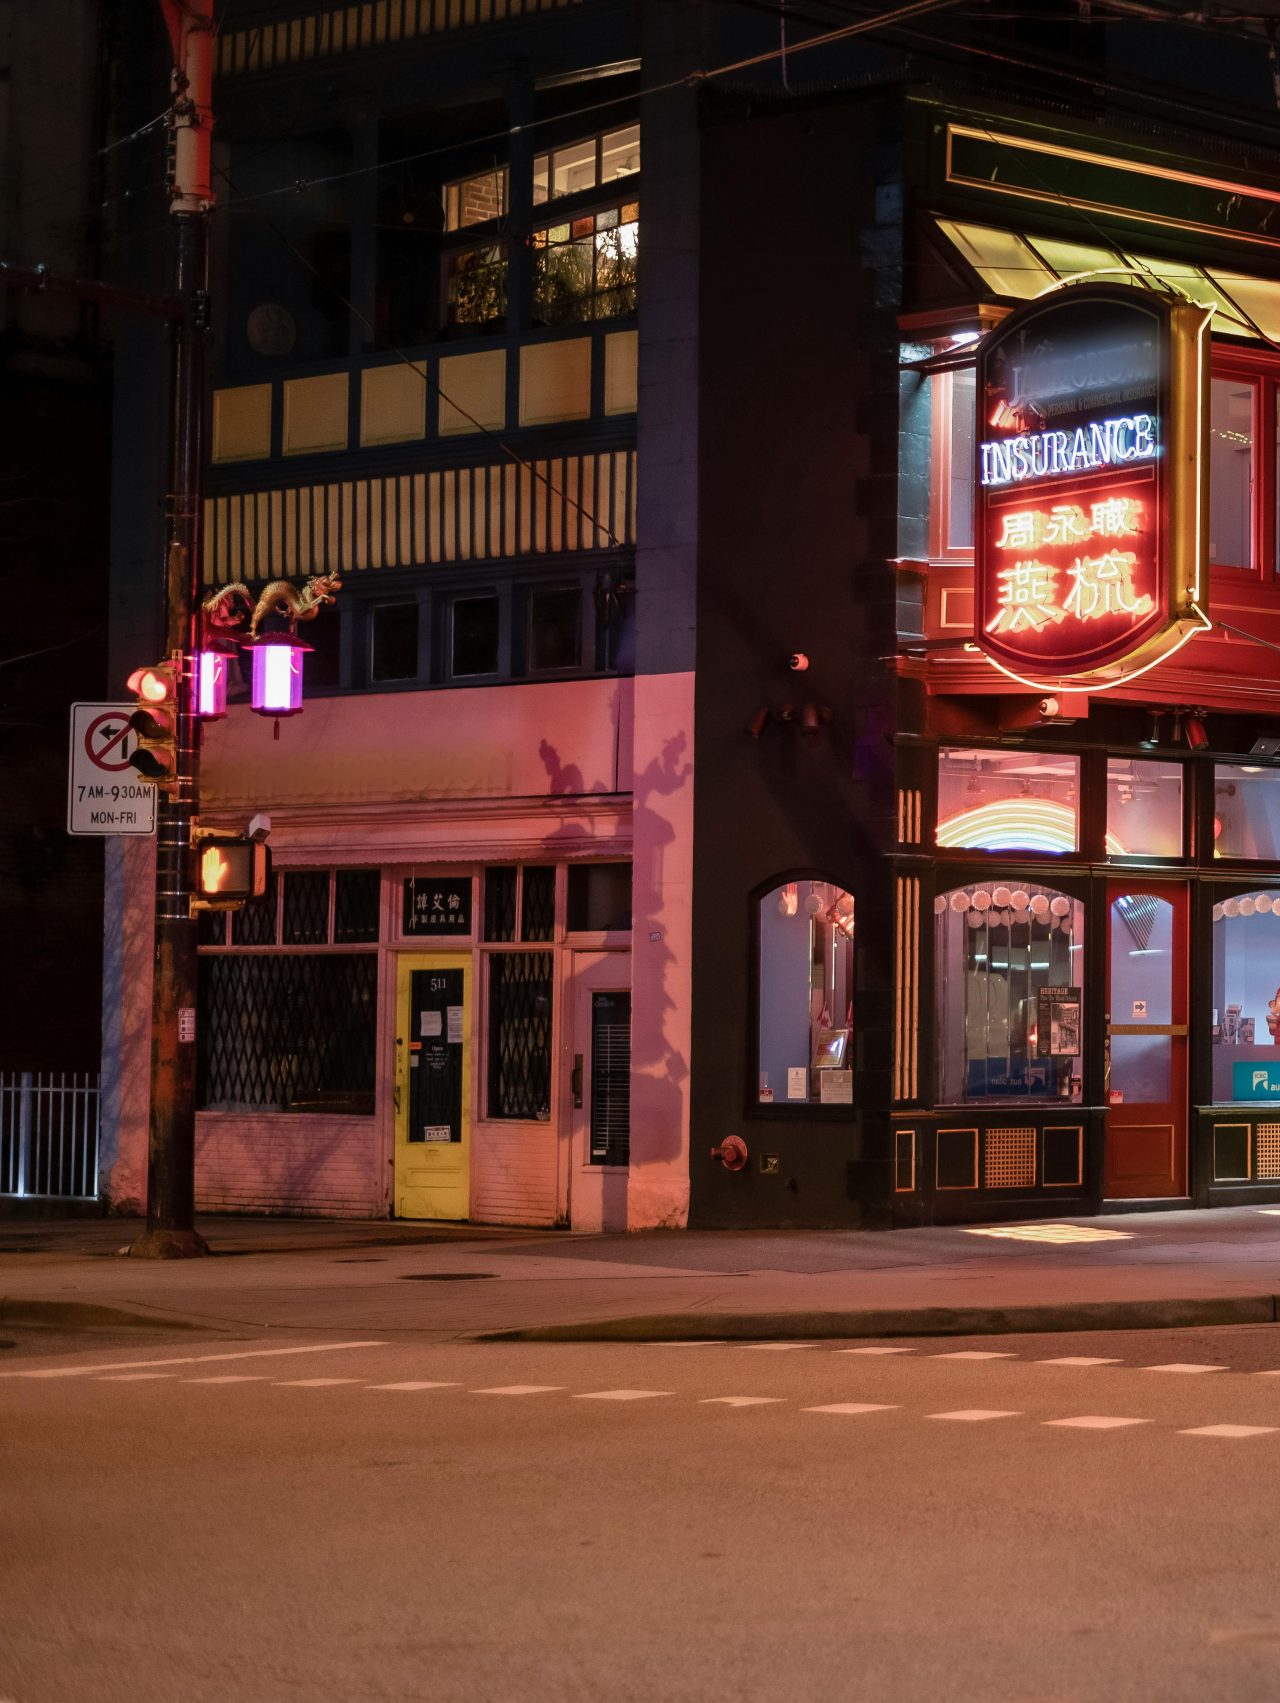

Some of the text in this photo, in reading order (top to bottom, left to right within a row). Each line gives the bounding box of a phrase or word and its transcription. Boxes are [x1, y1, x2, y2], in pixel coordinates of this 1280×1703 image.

[1047, 399, 1078, 417] PERSONAL
[1083, 390, 1121, 410] COMMERCIAL
[1122, 384, 1157, 402] INSURANCE
[981, 414, 1155, 486] INSURANCE
[90, 811, 137, 824] MON-FRI
[430, 978, 447, 992] 511
[1040, 987, 1069, 995] HERITAGE
